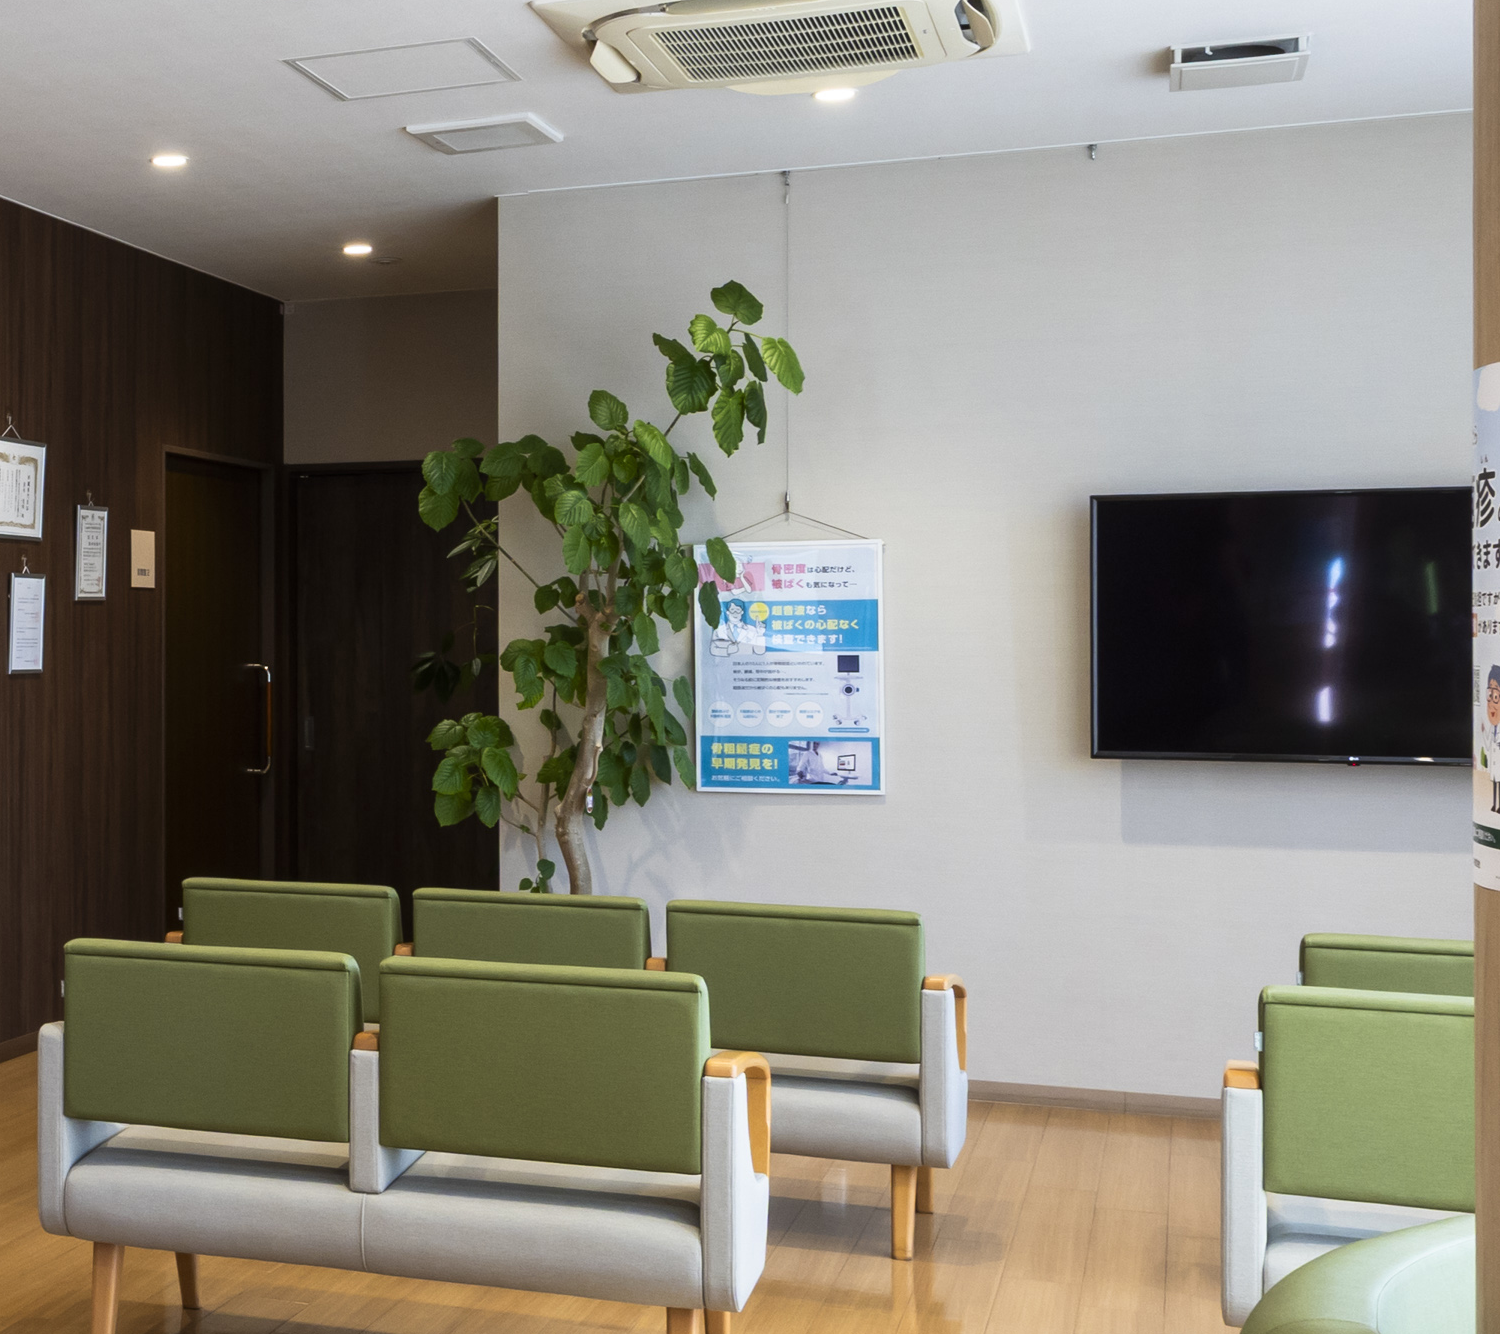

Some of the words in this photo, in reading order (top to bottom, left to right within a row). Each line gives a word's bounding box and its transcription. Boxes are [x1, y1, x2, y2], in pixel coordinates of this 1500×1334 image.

[771, 563, 856, 575] 骨密度は心配だけど、
[771, 605, 827, 616] 超音波なら
[771, 619, 859, 630] 被ばくの心配なく
[711, 743, 774, 755] 骨粗鬆症の
[711, 758, 778, 769] 早期発見を！
